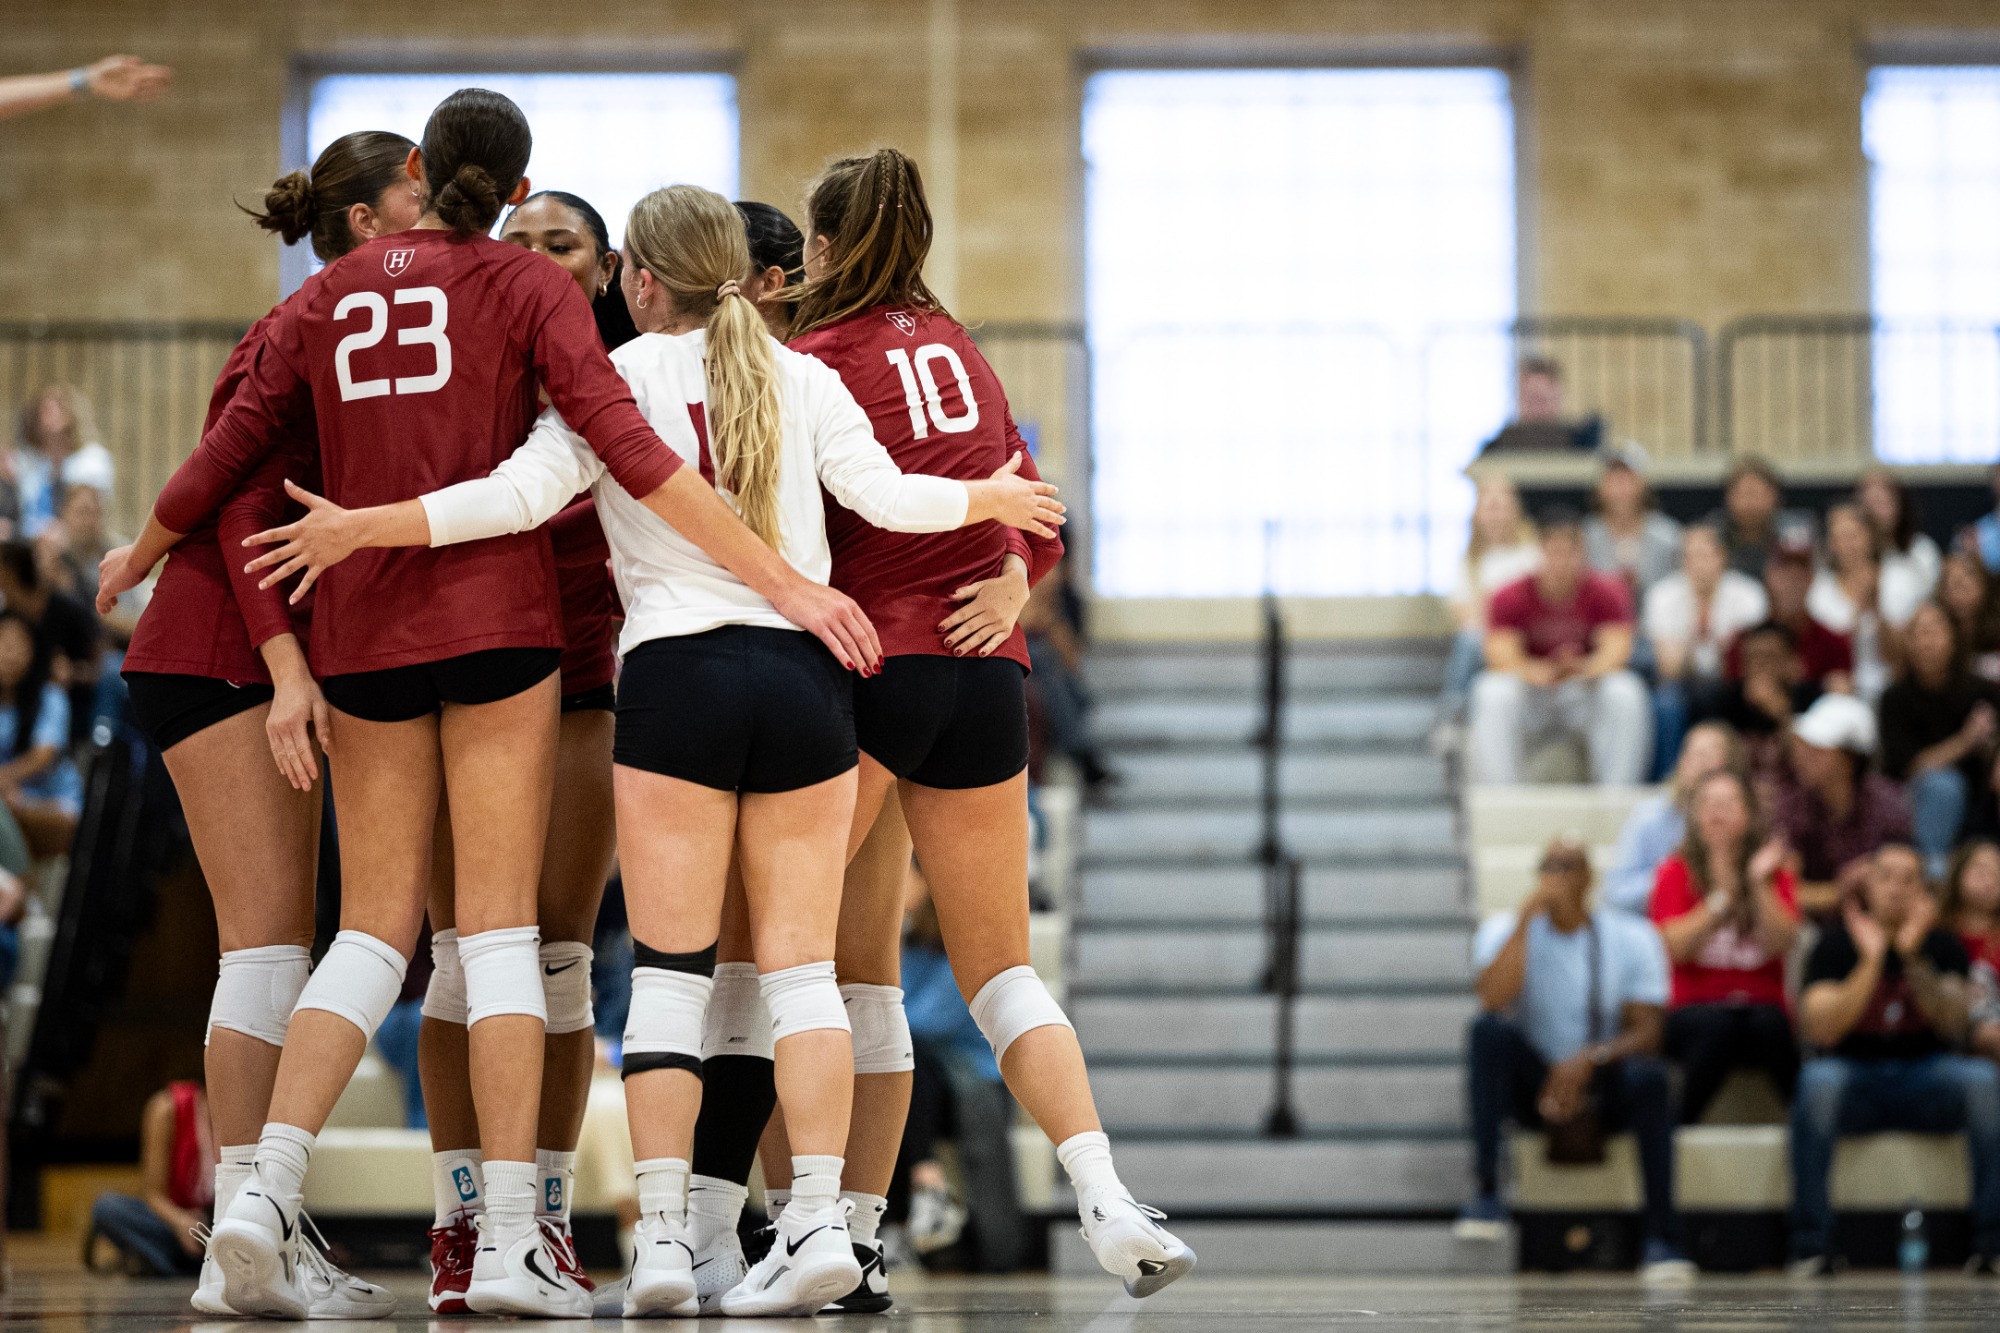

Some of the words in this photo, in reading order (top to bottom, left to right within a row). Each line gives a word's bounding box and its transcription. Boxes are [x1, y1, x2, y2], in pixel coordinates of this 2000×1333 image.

[389, 252, 407, 269] H
[333, 286, 452, 402] 23
[892, 314, 912, 328] H
[885, 343, 980, 440] 10
